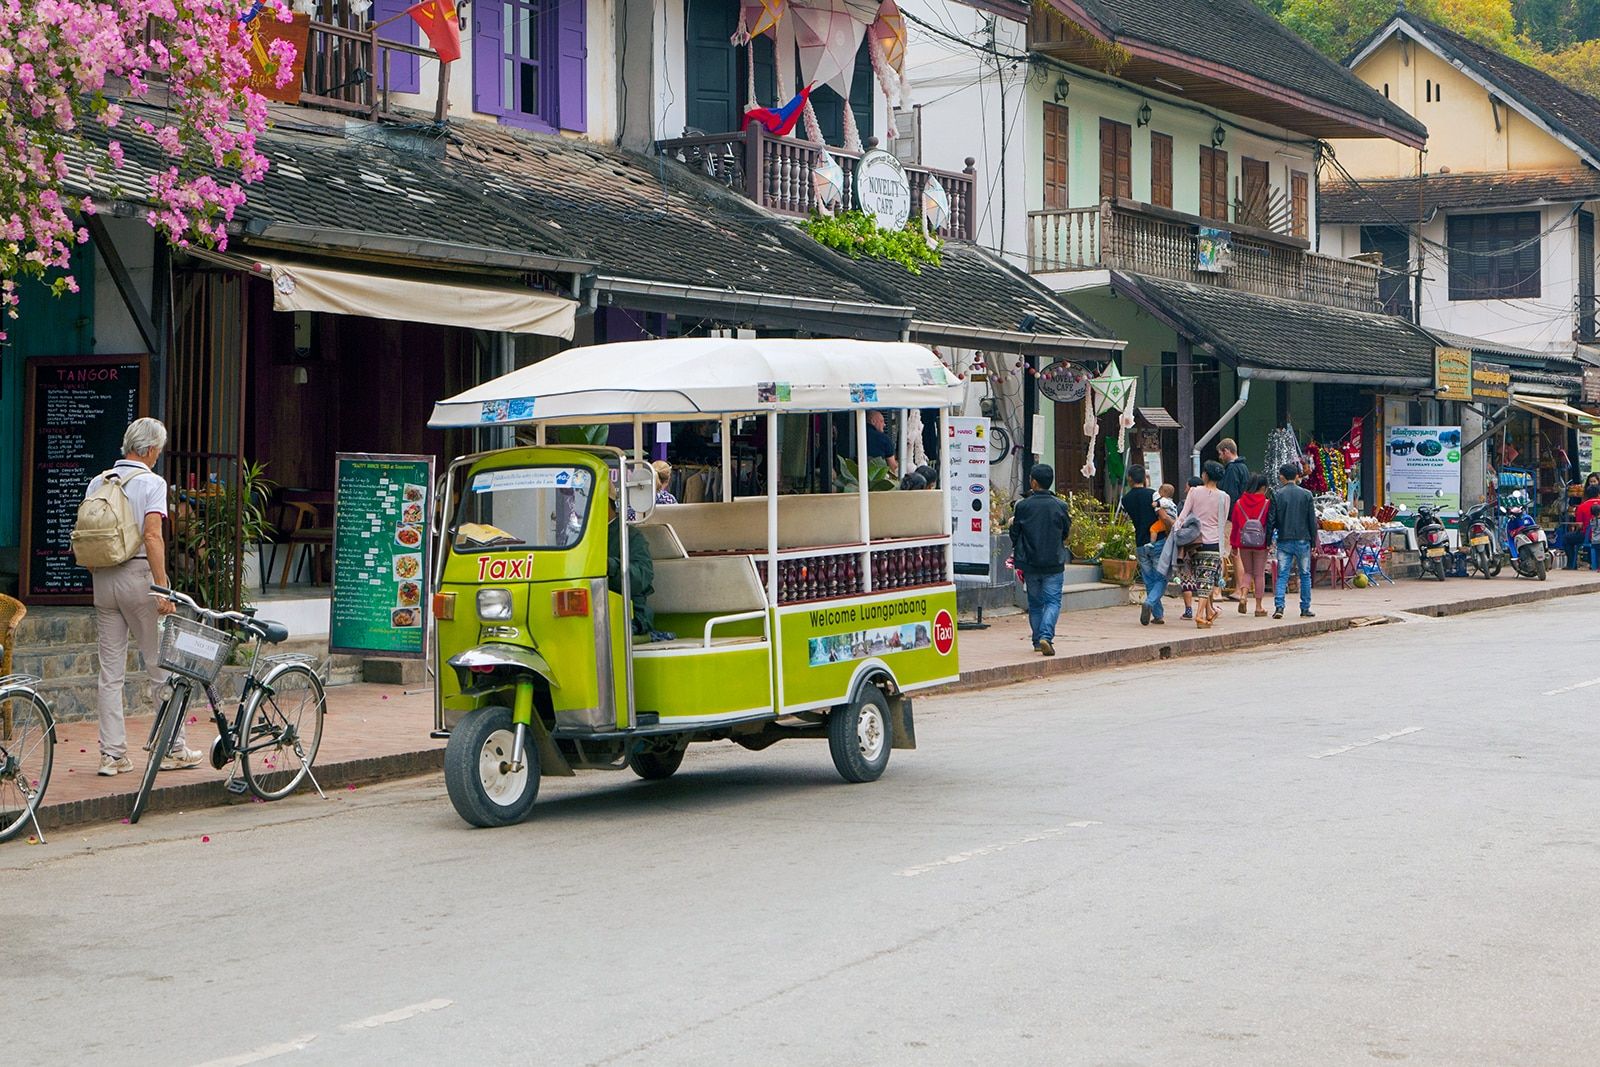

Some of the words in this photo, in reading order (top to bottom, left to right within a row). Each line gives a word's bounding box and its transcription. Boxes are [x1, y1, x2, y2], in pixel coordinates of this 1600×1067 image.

[868, 176, 899, 198] NOVELTY
[876, 197, 894, 215] CAFE
[57, 369, 118, 380] TANGOR
[1050, 374, 1077, 383] NOVELT
[1056, 383, 1074, 391] CAFE
[478, 554, 533, 581] Taxi
[809, 609, 856, 627] Welcome
[935, 622, 953, 640] Taxi
